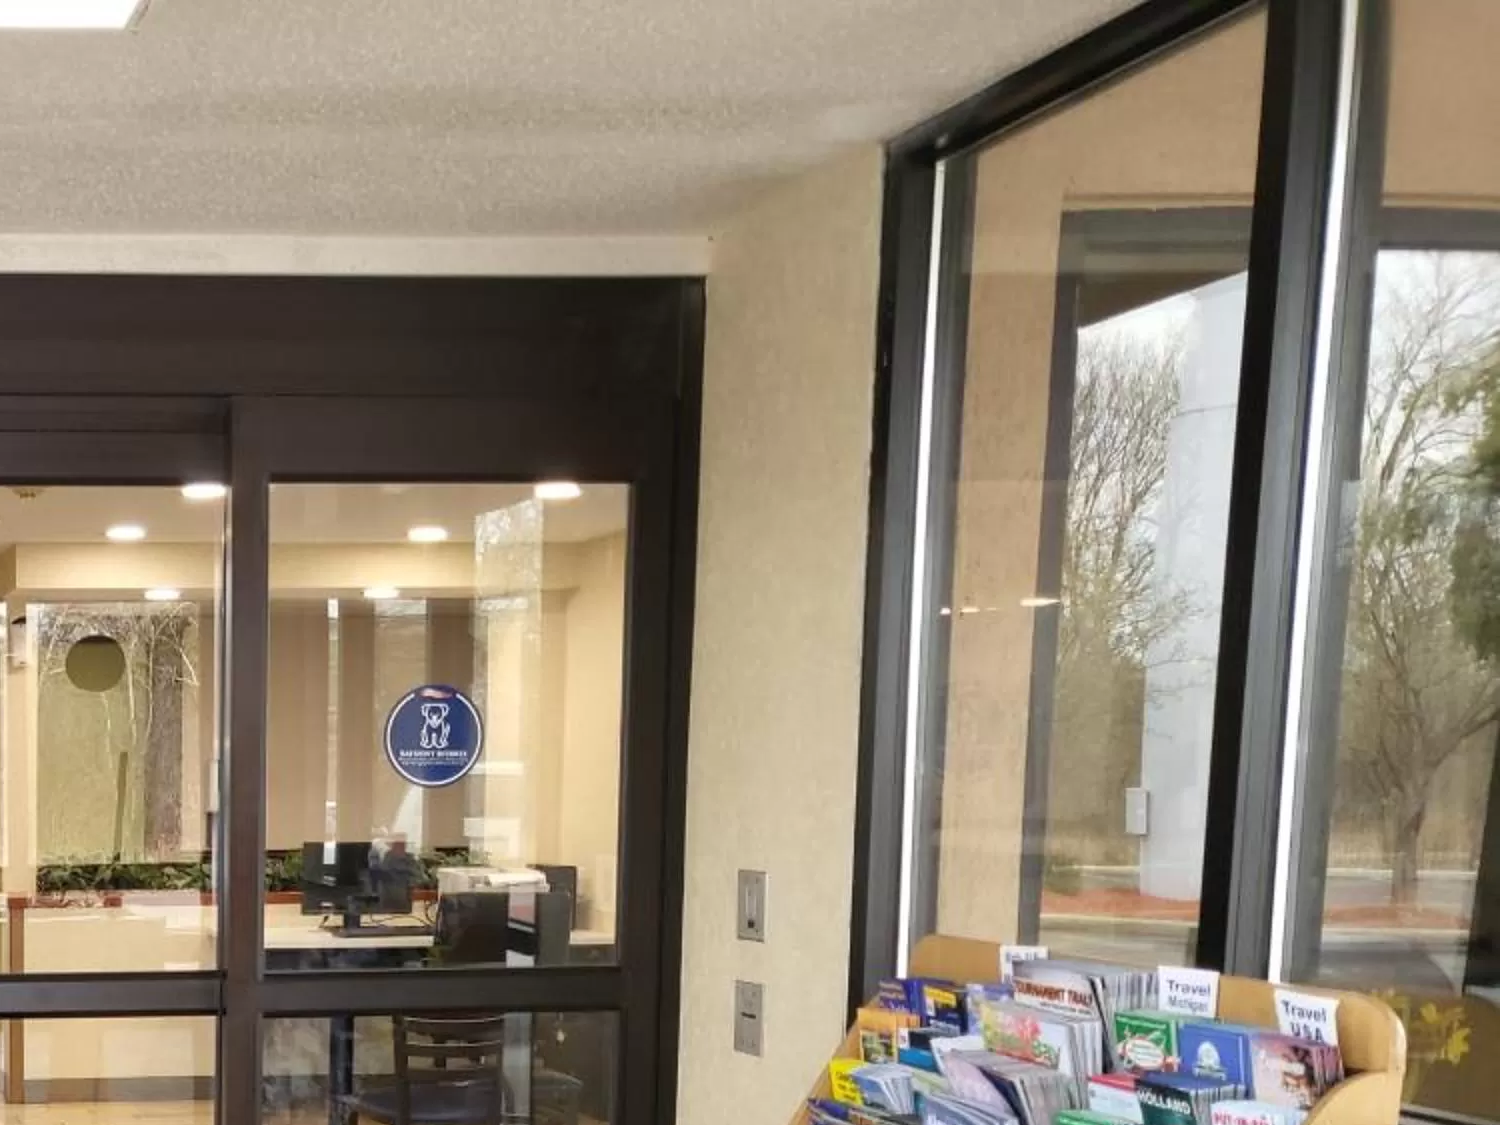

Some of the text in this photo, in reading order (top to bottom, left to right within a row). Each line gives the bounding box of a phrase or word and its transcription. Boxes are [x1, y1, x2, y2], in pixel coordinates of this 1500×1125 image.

[1166, 979, 1211, 997] Travel
[1280, 999, 1327, 1024] Travel
[1136, 1089, 1191, 1115] HOLLAND
